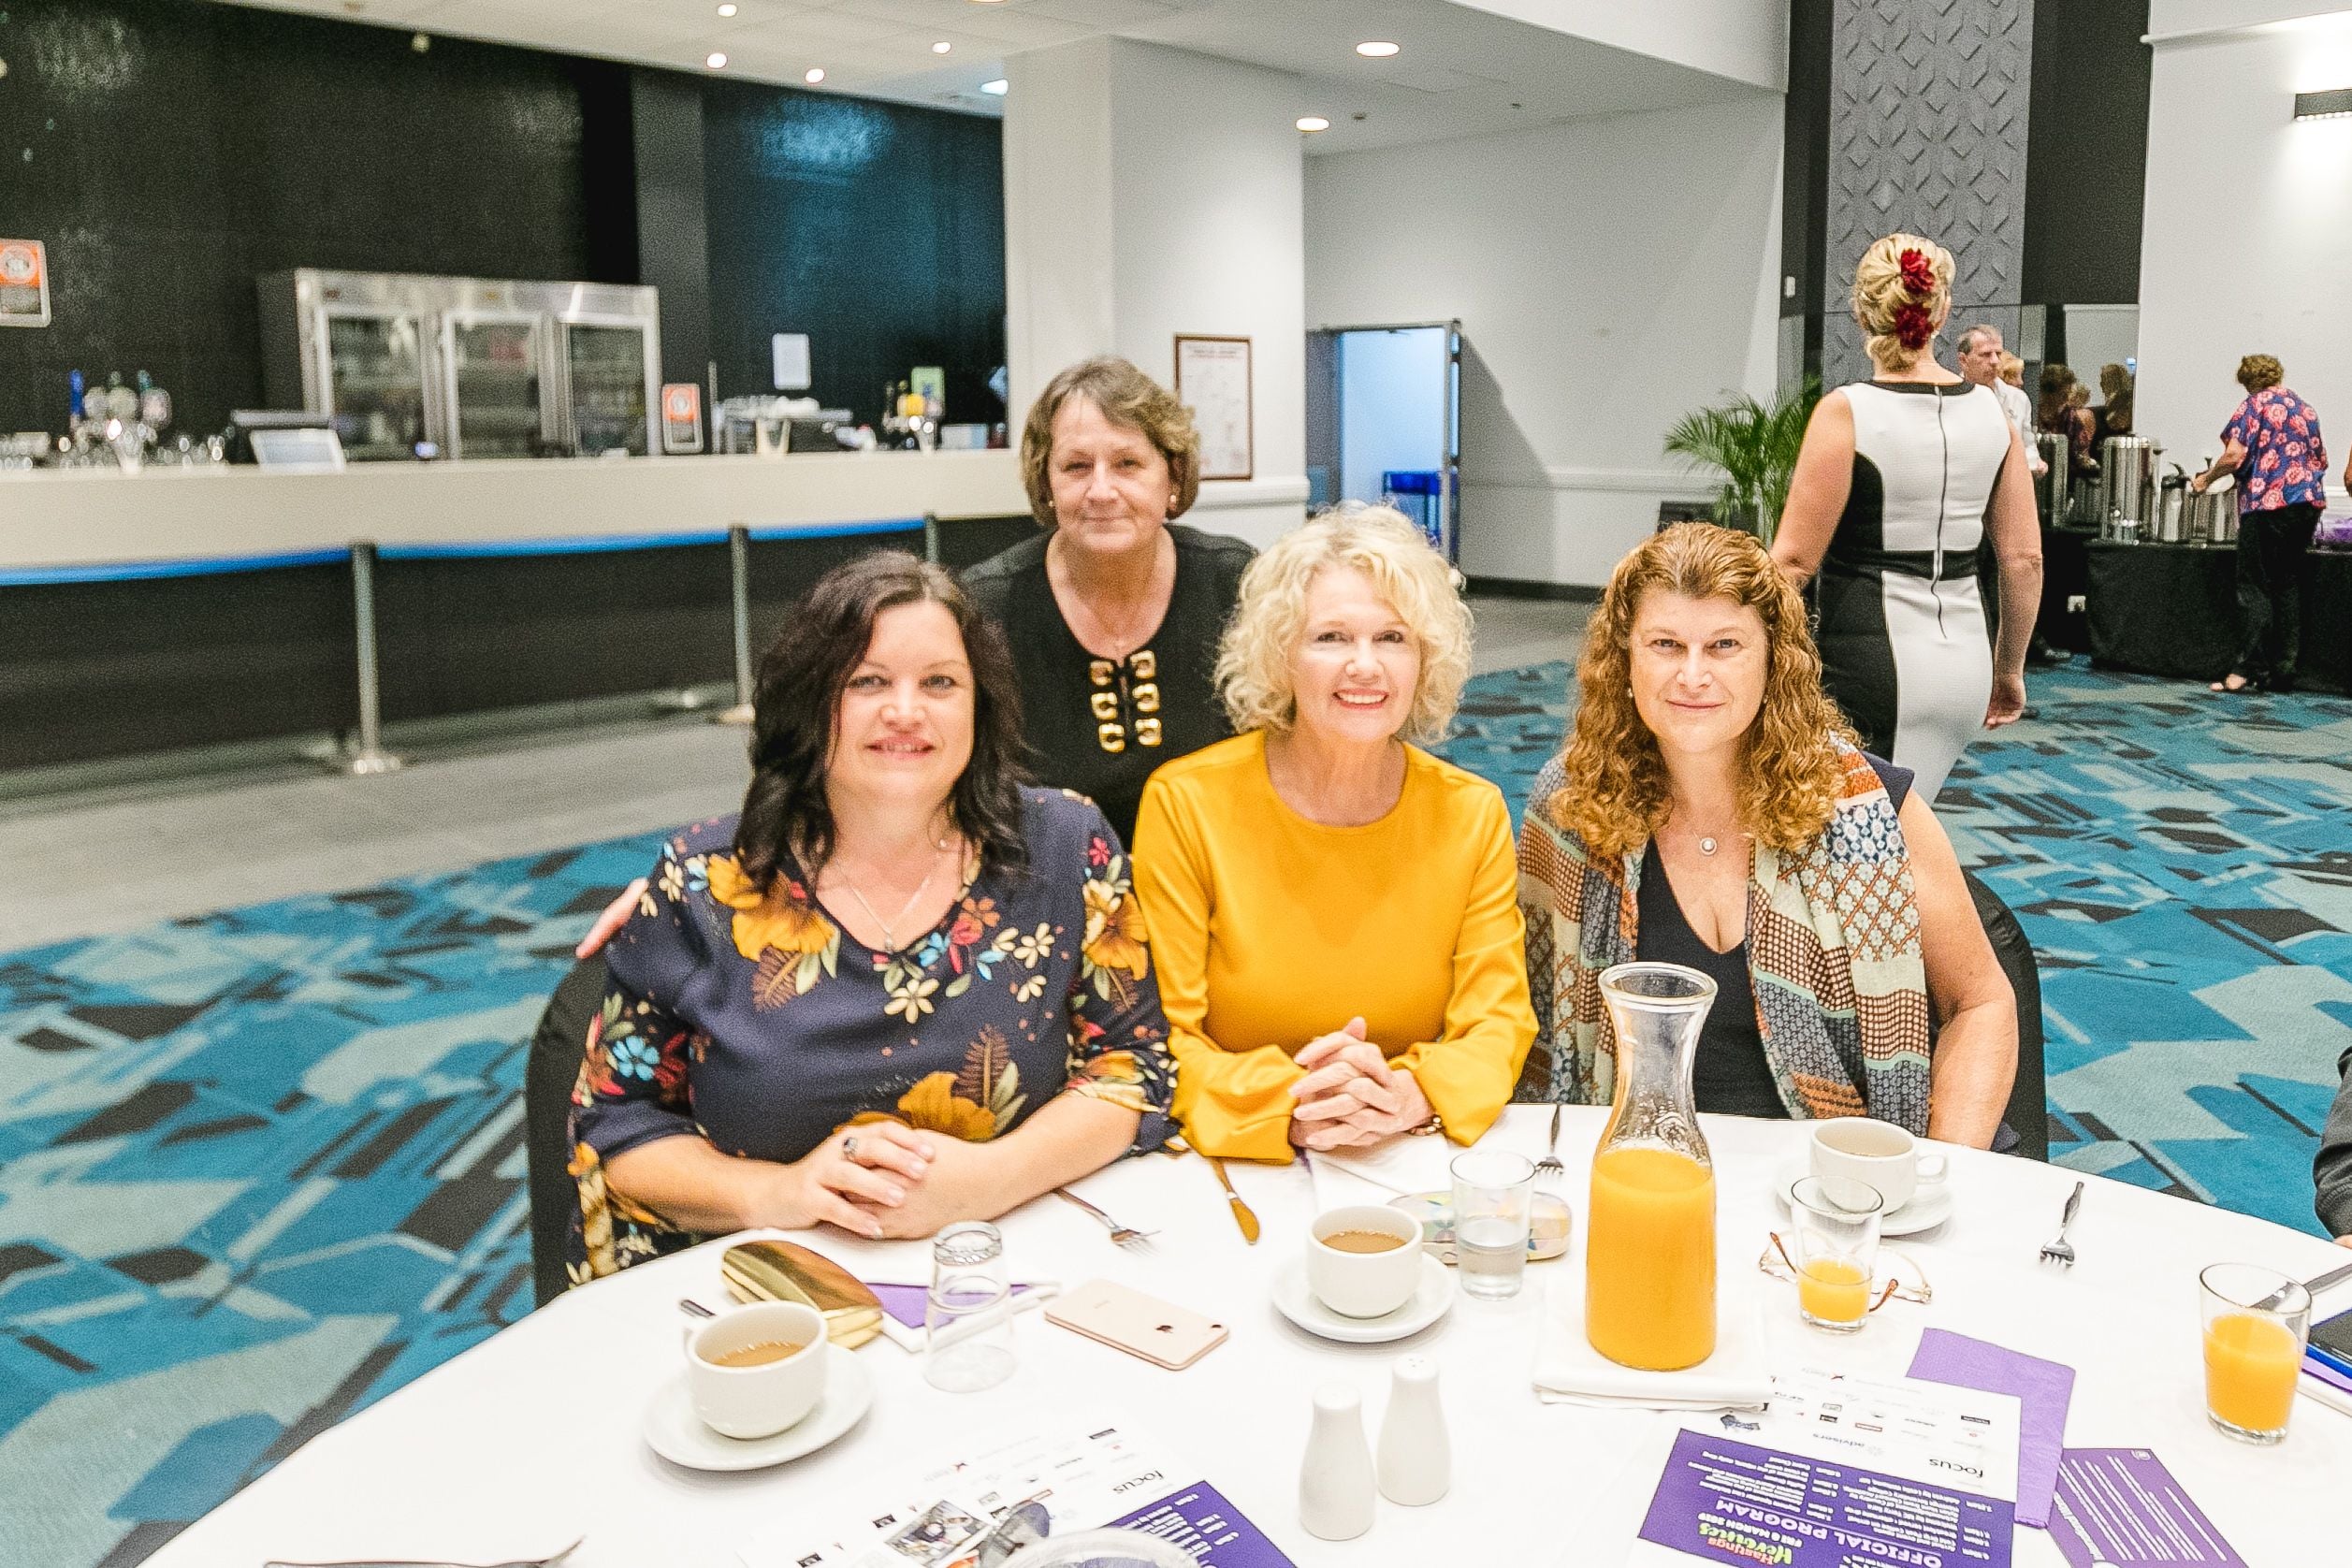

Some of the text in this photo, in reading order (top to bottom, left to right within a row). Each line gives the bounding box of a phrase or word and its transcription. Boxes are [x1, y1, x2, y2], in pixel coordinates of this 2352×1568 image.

[1929, 1459, 1984, 1478] focus
[1112, 1470, 1164, 1494] focus
[1716, 1500, 1828, 1540] PROGRAM
[1725, 1519, 1771, 1539] MARCH
[1706, 1536, 1776, 1565] Hastings
[1780, 1534, 1803, 1547] FRI
[1834, 1532, 1942, 1568] OFFICIAL
